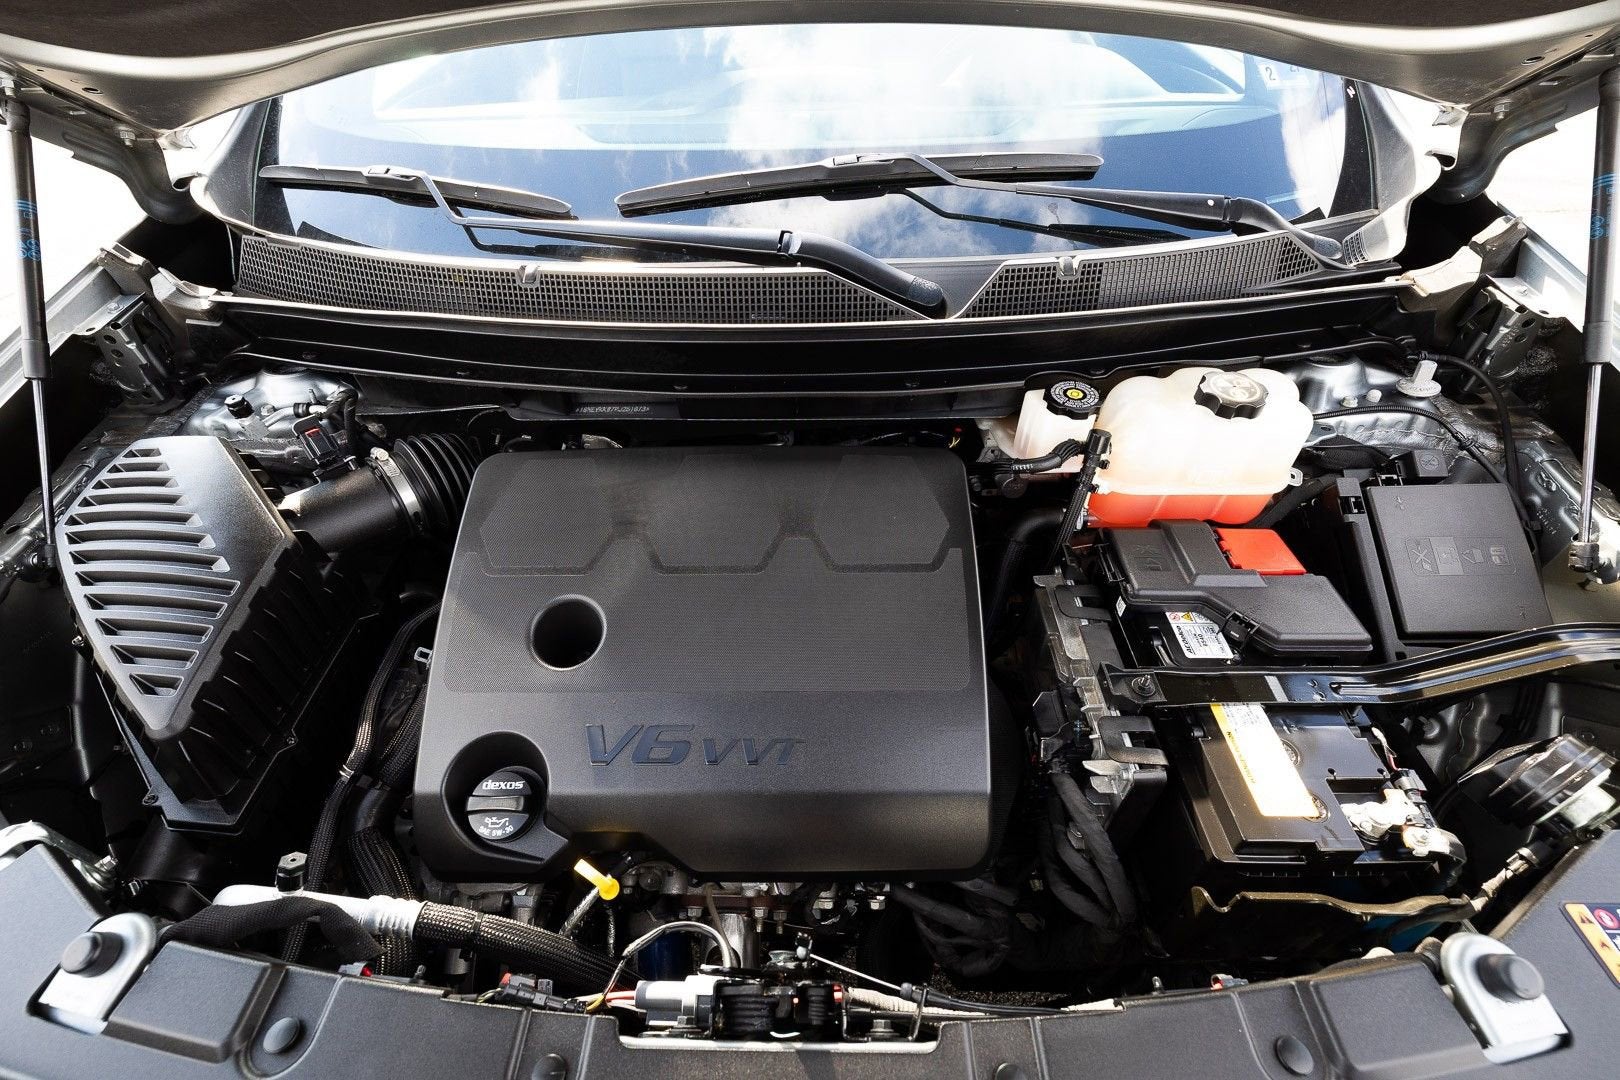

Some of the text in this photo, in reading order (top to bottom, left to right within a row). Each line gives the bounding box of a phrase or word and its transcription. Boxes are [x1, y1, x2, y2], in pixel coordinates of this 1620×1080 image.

[585, 723, 807, 766] V6 VVT
[482, 779, 526, 790] dexos
[478, 825, 514, 837] SAE 5W-30
